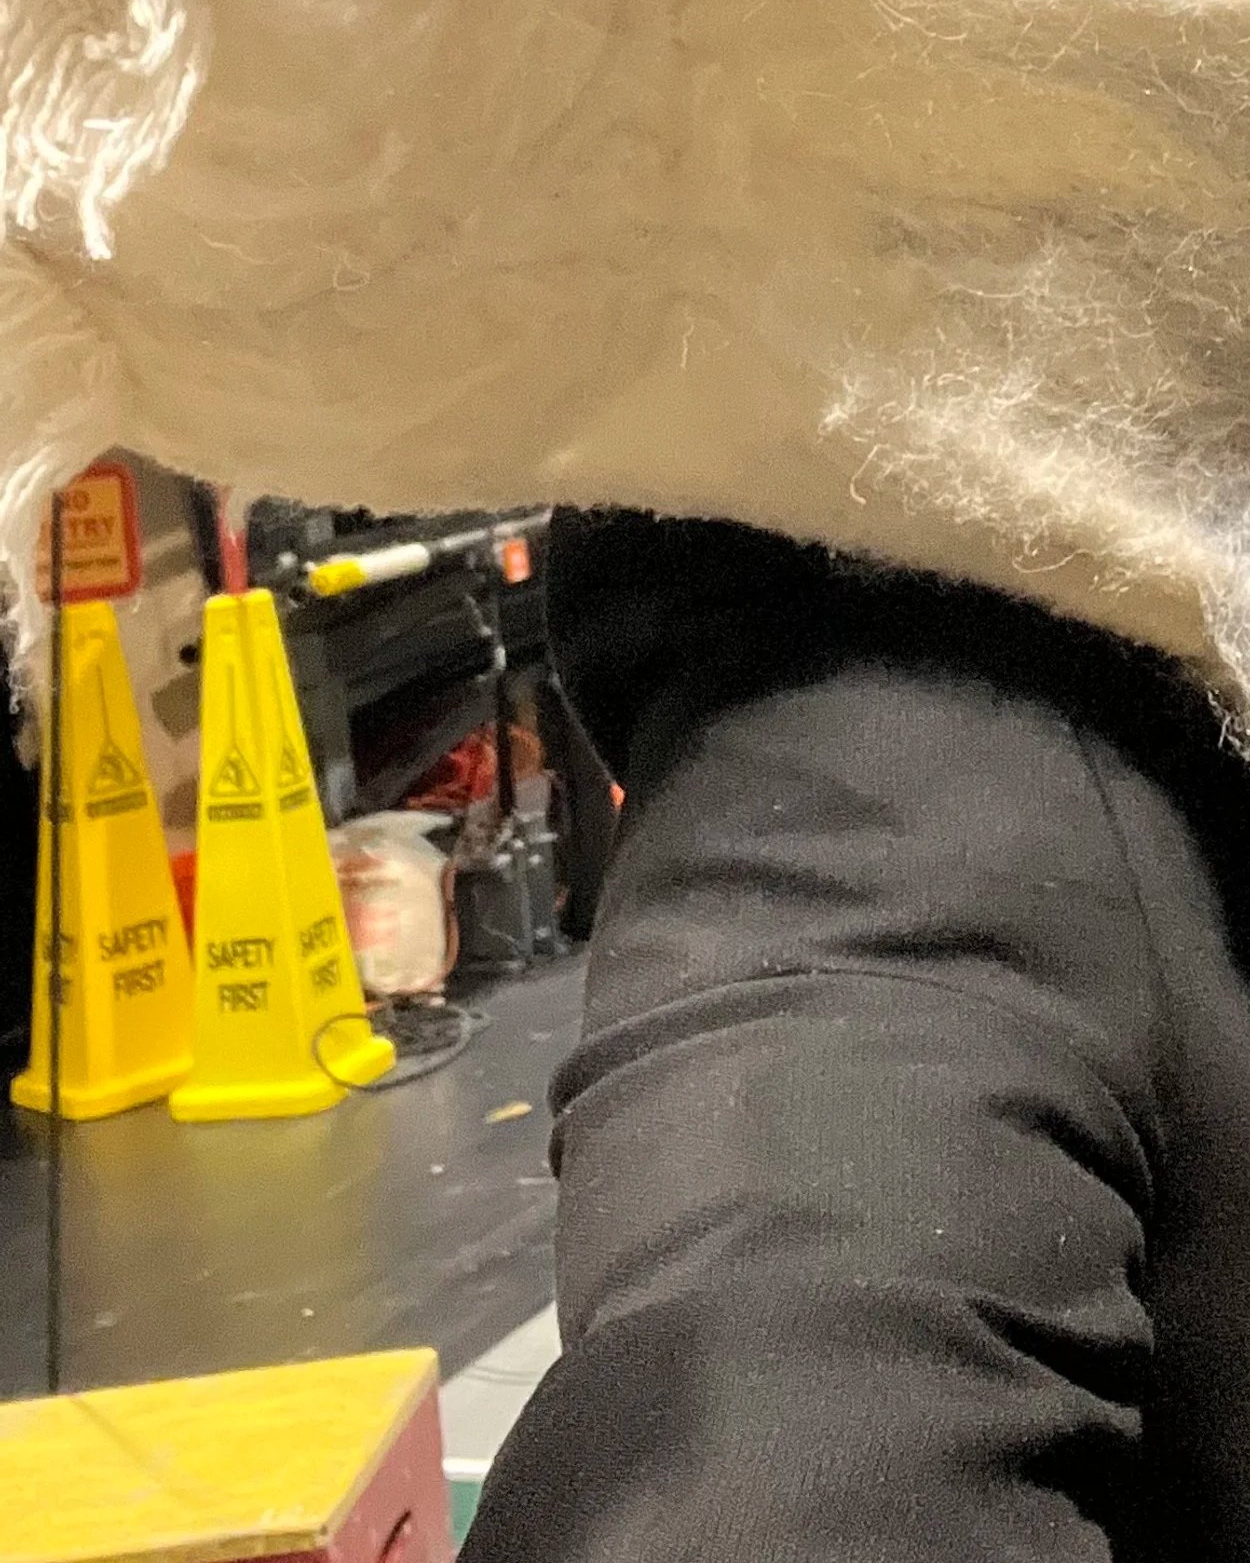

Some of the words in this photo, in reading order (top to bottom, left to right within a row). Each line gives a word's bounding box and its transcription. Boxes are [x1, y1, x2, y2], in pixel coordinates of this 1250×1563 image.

[99, 917, 167, 962] SAFETY
[207, 938, 274, 970] SAFETY
[114, 959, 165, 999] FIRST
[218, 981, 269, 1012] FIRST
